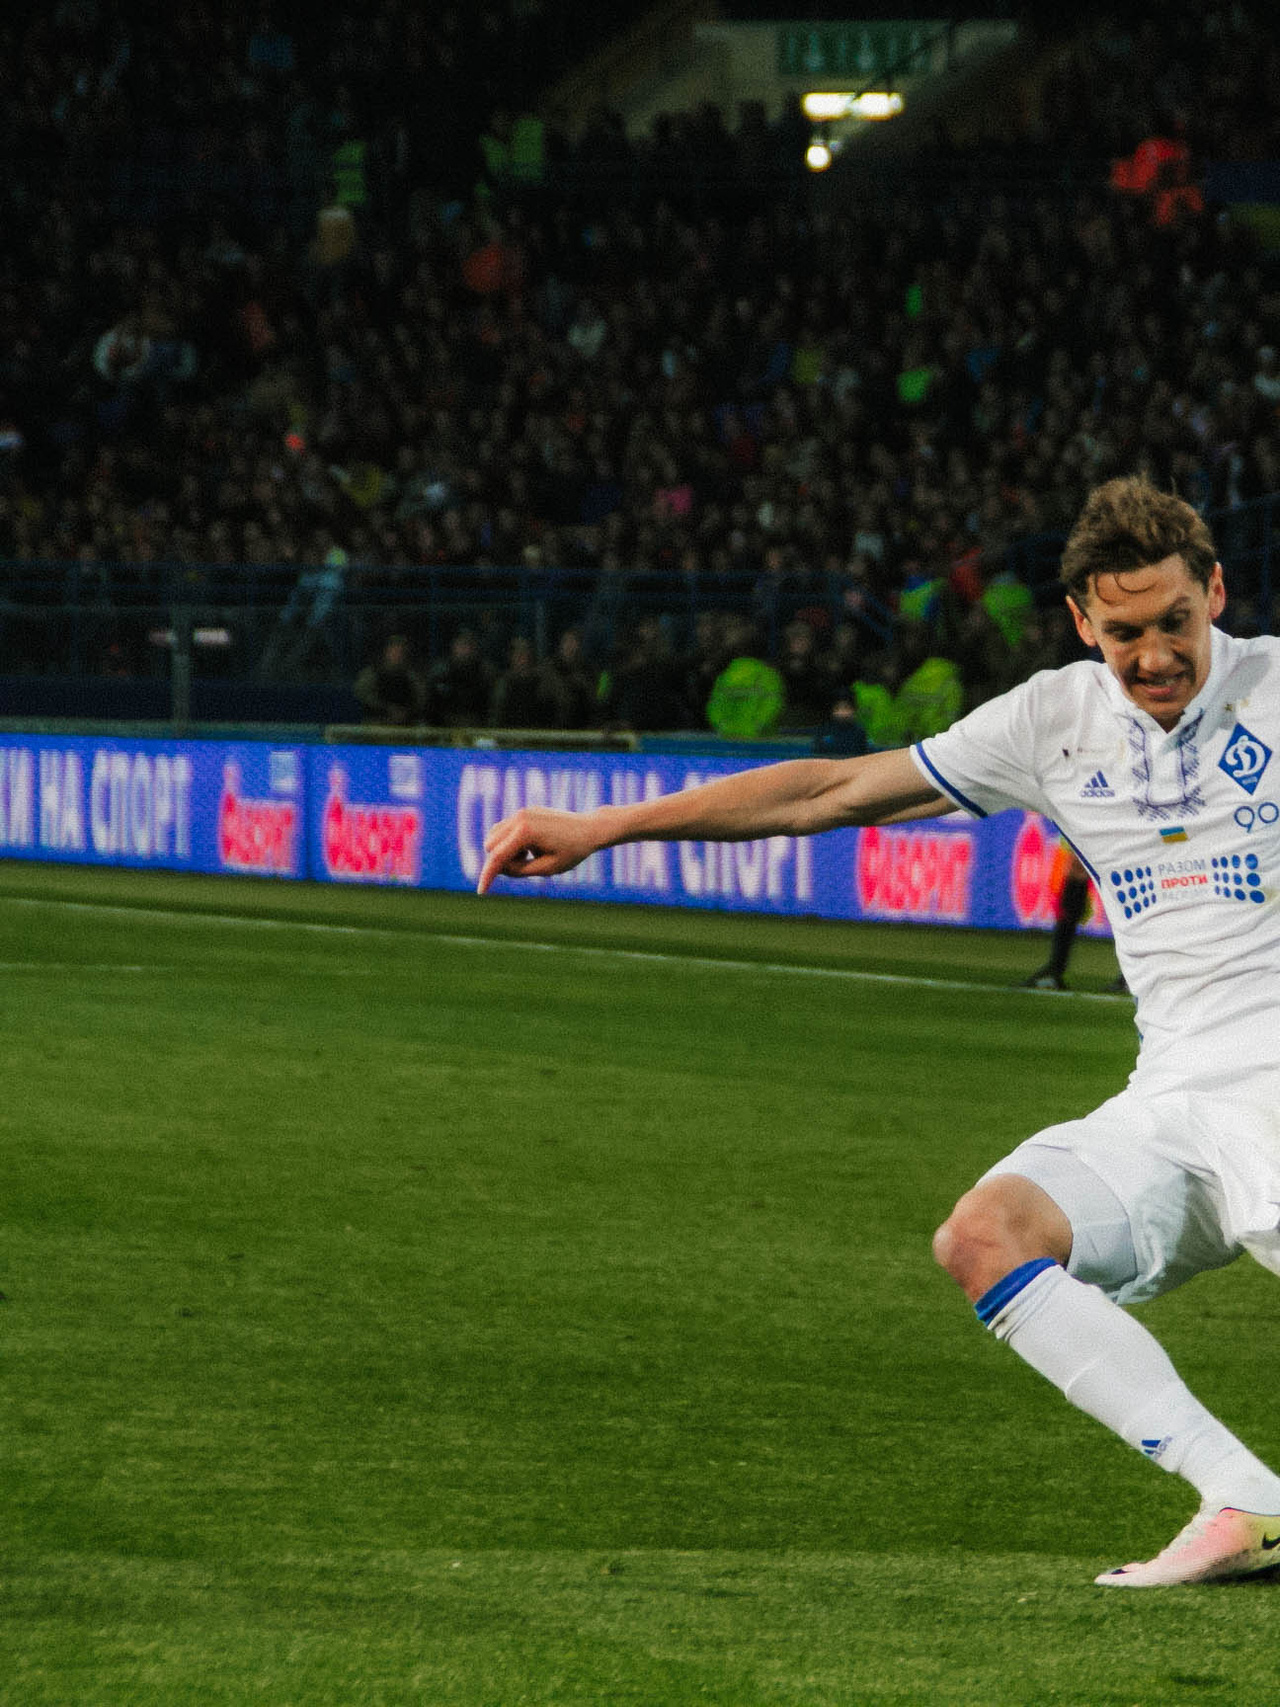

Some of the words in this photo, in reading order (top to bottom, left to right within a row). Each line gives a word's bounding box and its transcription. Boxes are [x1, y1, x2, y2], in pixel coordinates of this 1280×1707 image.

[1080, 789, 1115, 797] adidas
[1233, 802, 1280, 833] 90
[1157, 859, 1206, 875] РАЗОМ
[1160, 873, 1208, 889] ПРОТИ
